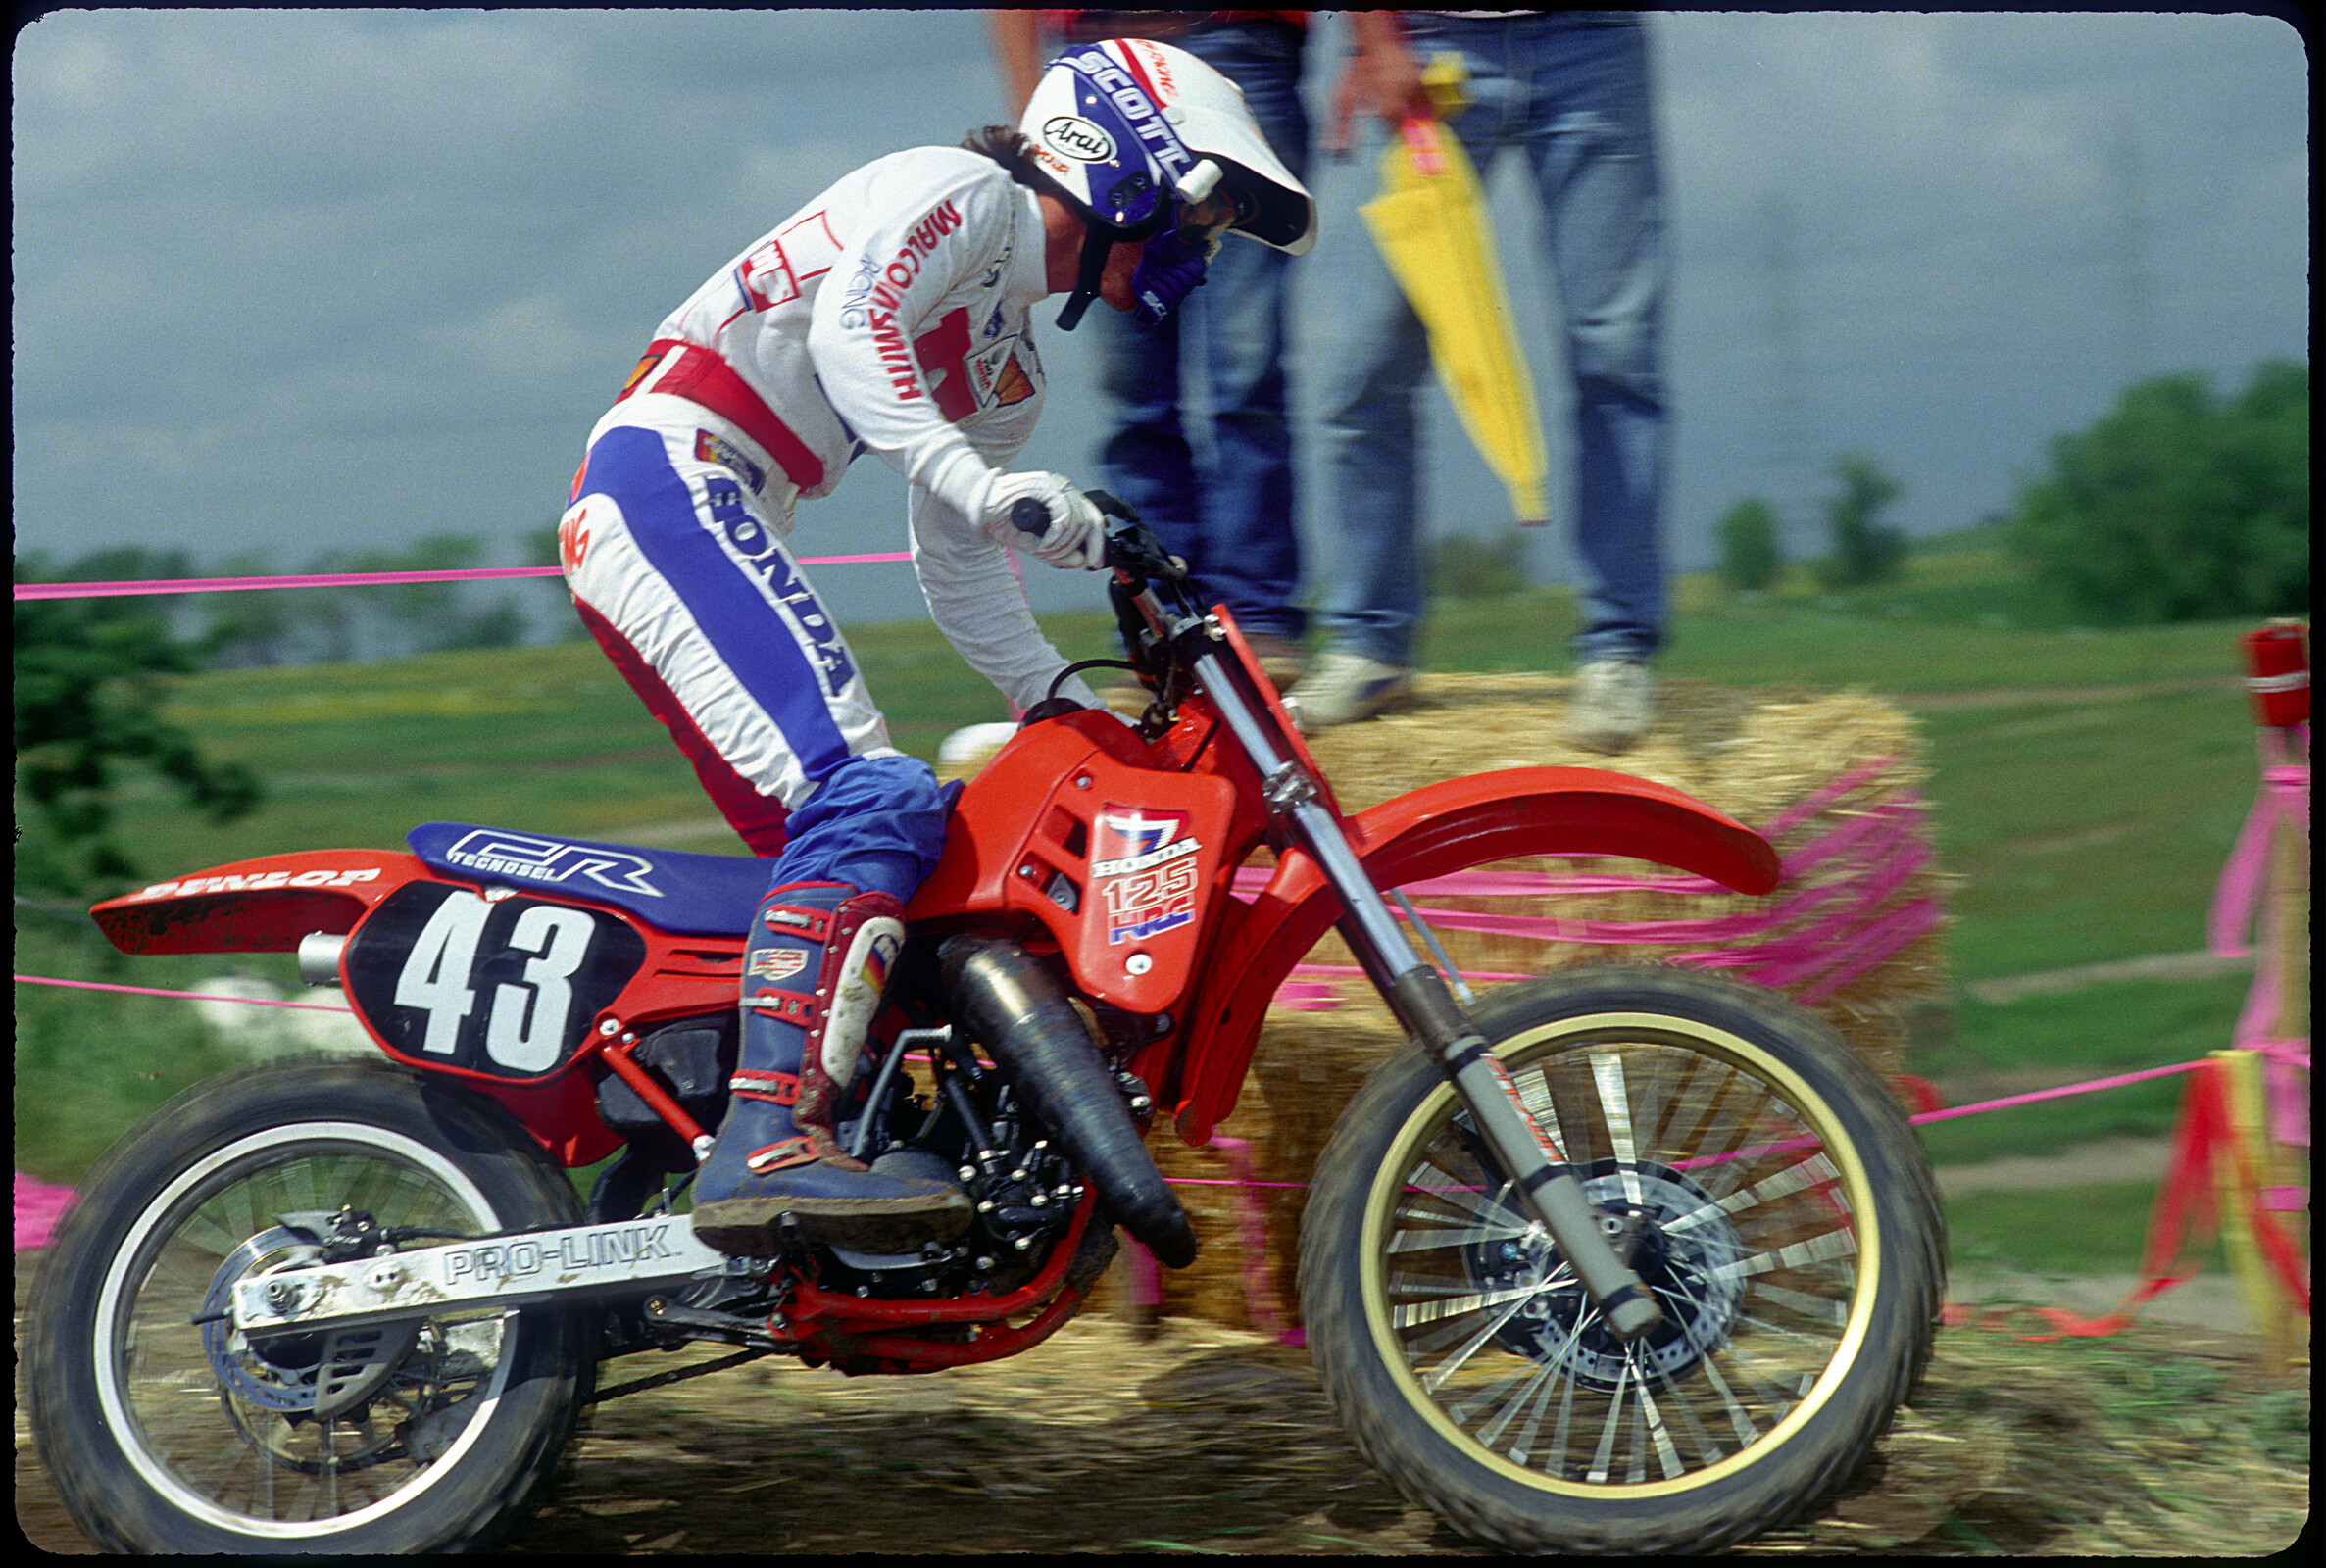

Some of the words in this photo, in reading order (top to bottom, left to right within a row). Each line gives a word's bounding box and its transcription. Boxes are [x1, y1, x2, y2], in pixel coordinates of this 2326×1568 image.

[1054, 121, 1106, 154] Arai
[1078, 50, 1192, 171] SCOTT
[869, 307, 923, 401] SMITH
[705, 475, 855, 697] HONDA
[128, 868, 381, 902] DUNLOP
[446, 829, 666, 898] CR
[450, 851, 559, 882] TECNOSEL
[1092, 836, 1203, 879] HONDA
[1102, 857, 1199, 914] 125
[1108, 892, 1196, 946] HRC
[393, 890, 596, 1073] 43
[444, 1223, 670, 1285] PRO-LINK
